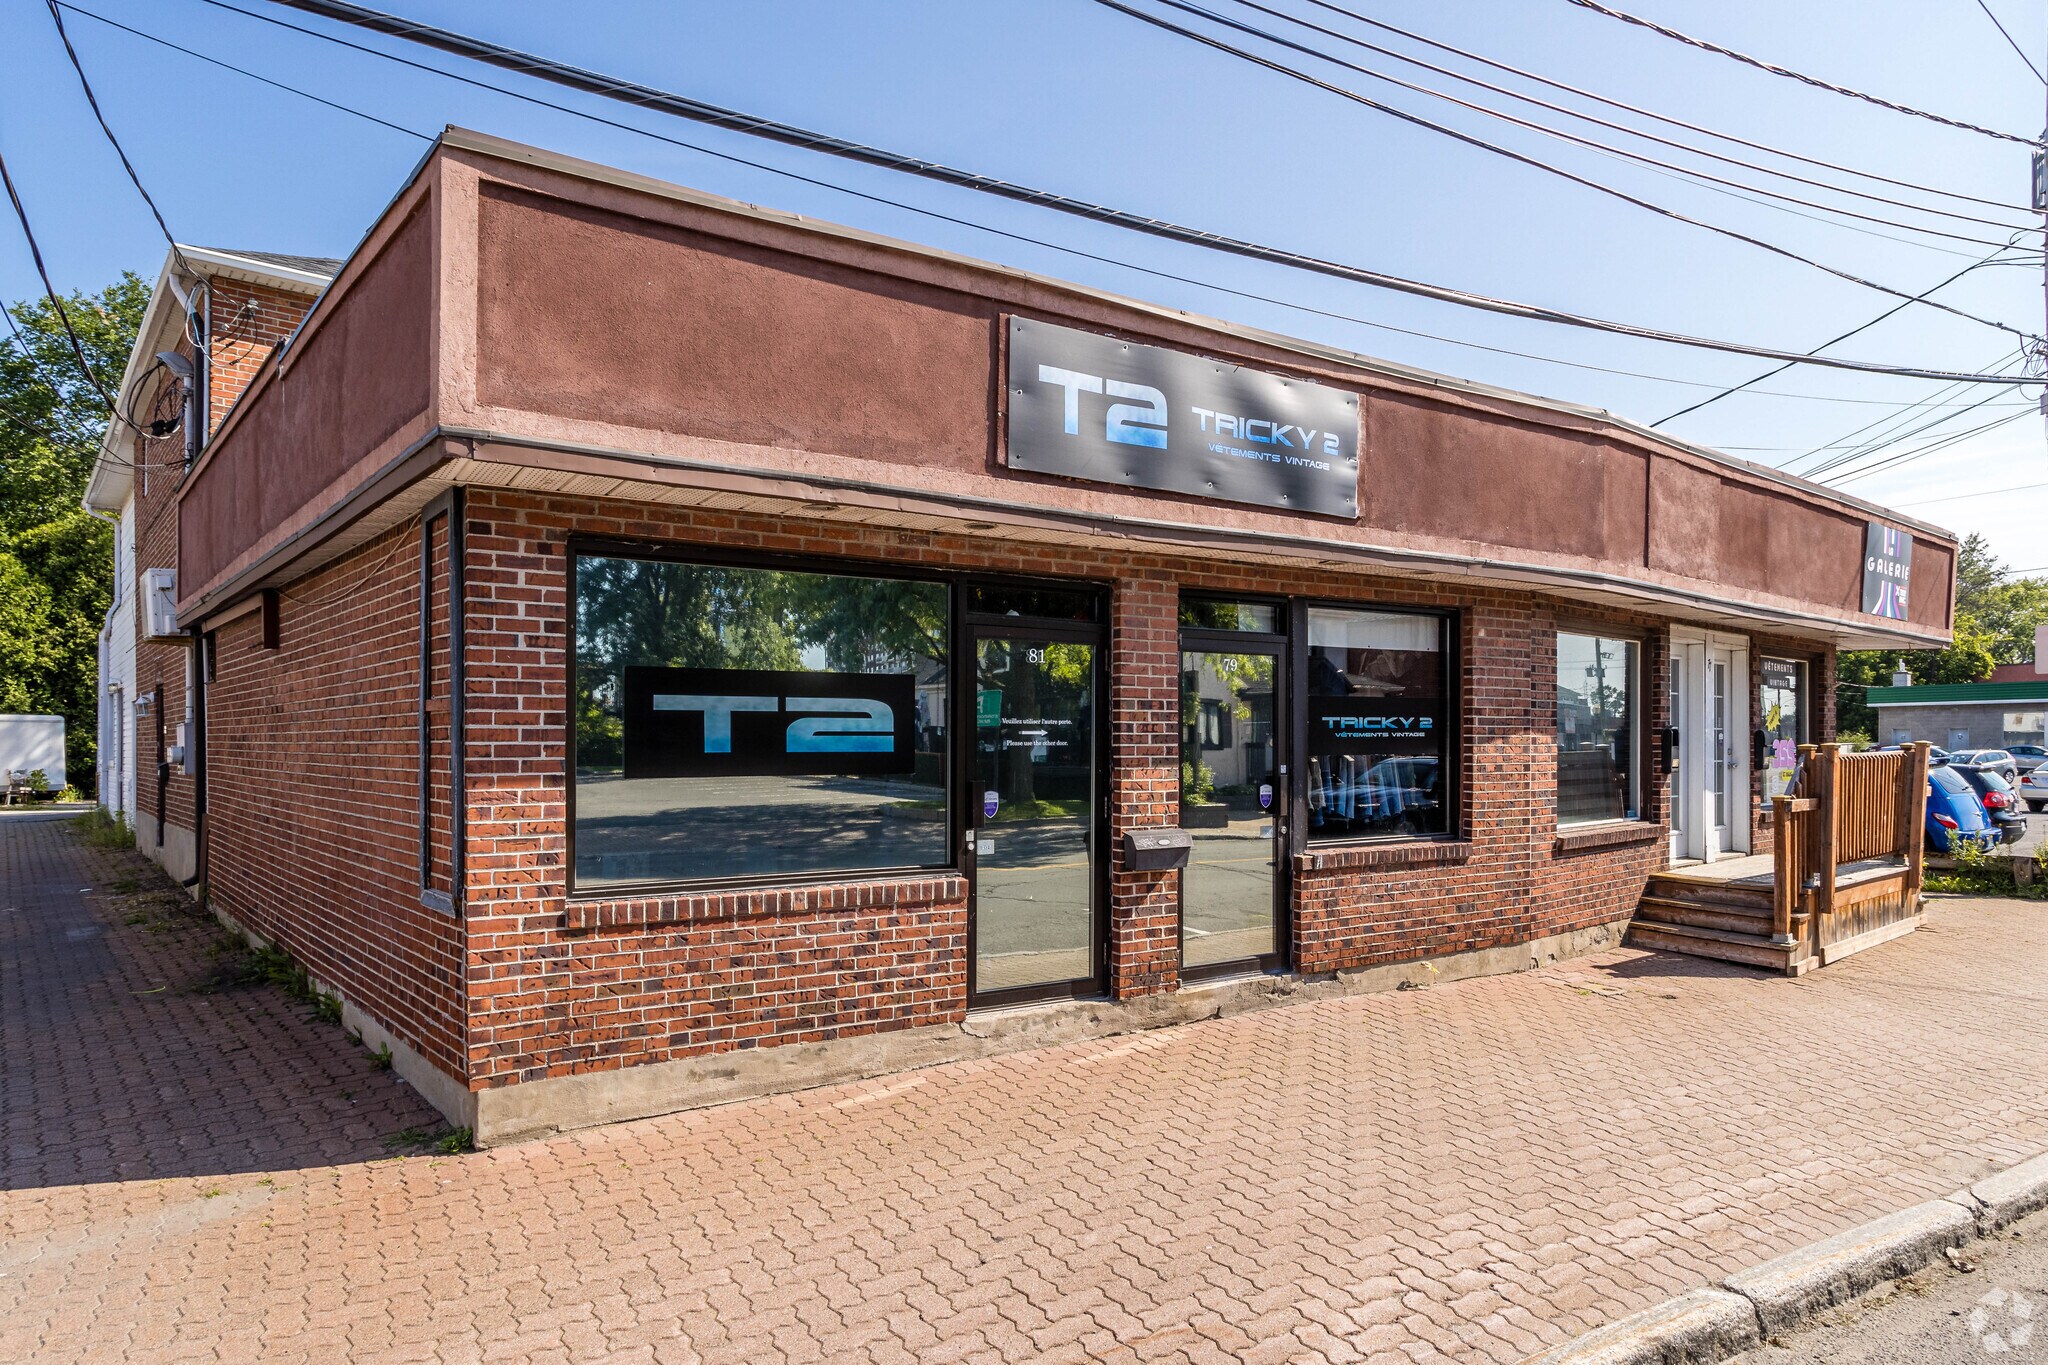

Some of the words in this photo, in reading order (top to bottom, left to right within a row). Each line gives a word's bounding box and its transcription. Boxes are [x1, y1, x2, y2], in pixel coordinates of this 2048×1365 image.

[1038, 363, 1168, 450] T2
[1191, 406, 1317, 449] TRICKY
[1323, 431, 1340, 456] 2
[1207, 442, 1281, 464] VÊTEMENTS
[1285, 455, 1330, 471] VINTAGE
[1867, 556, 1910, 581] GALERIE
[1028, 648, 1045, 663] 81
[1223, 658, 1238, 672] 79
[653, 694, 894, 753] T2
[1321, 716, 1415, 729] TRICKY
[1419, 716, 1433, 729] 2
